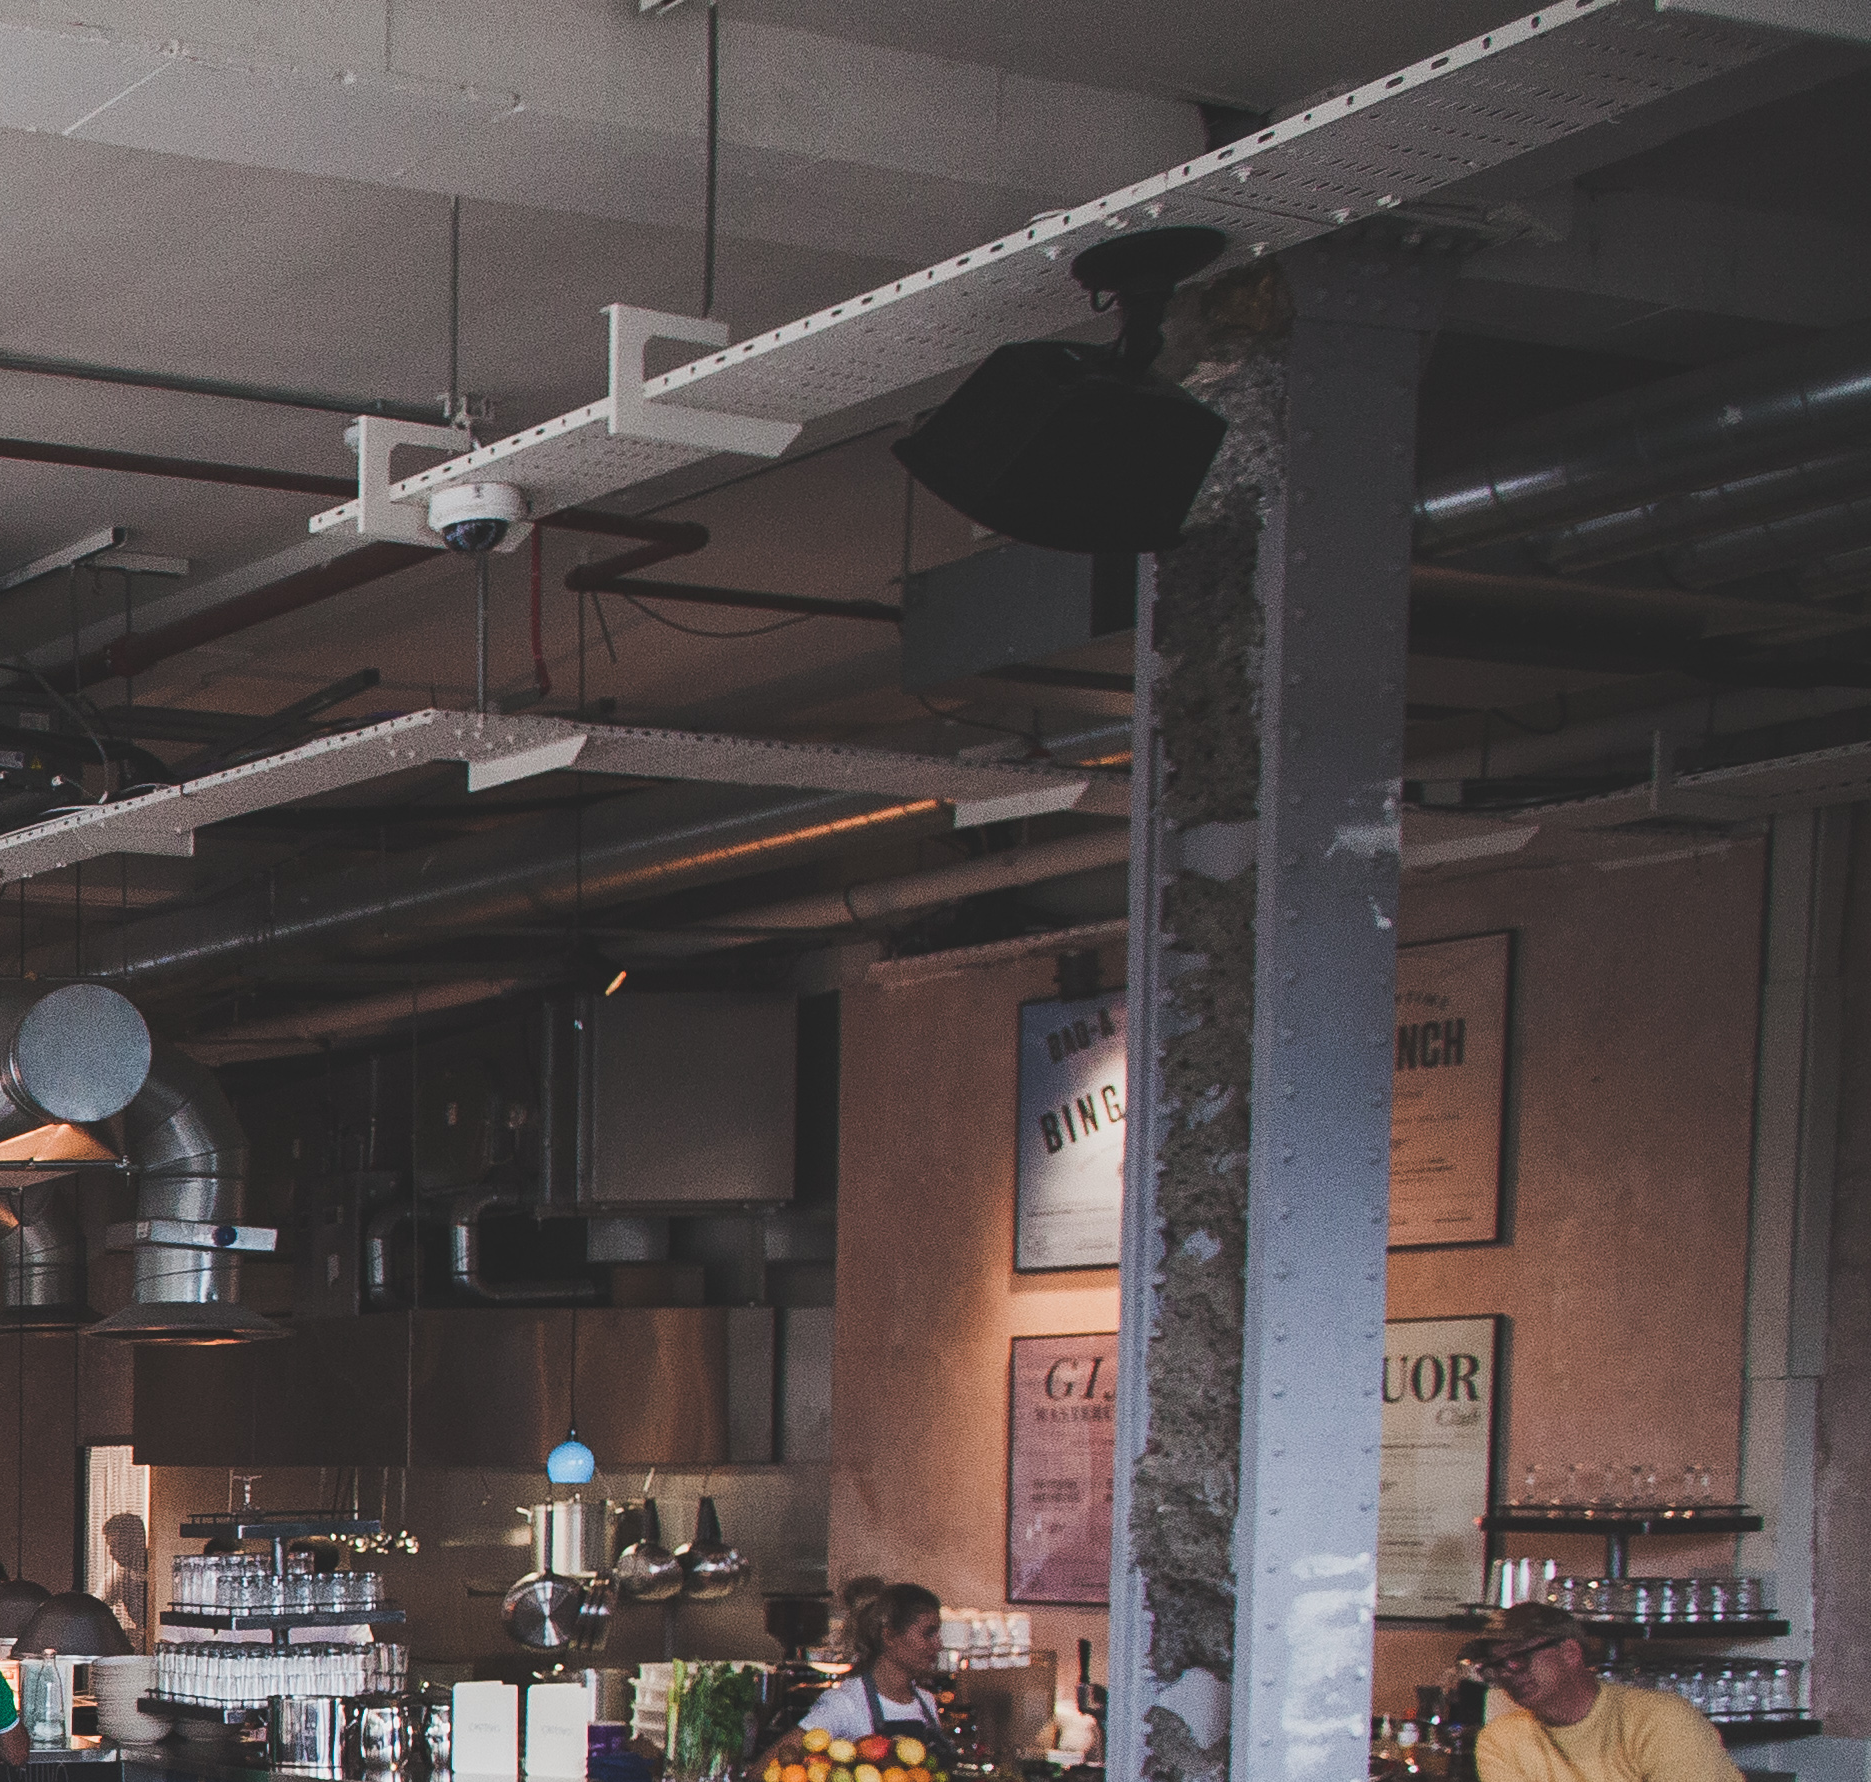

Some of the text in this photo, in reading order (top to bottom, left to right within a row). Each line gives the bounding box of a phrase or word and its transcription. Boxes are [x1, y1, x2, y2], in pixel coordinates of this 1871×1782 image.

[1396, 1018, 1465, 1069] NCH
[1044, 1356, 1116, 1401] GI
[1382, 1354, 1480, 1403] UOR
